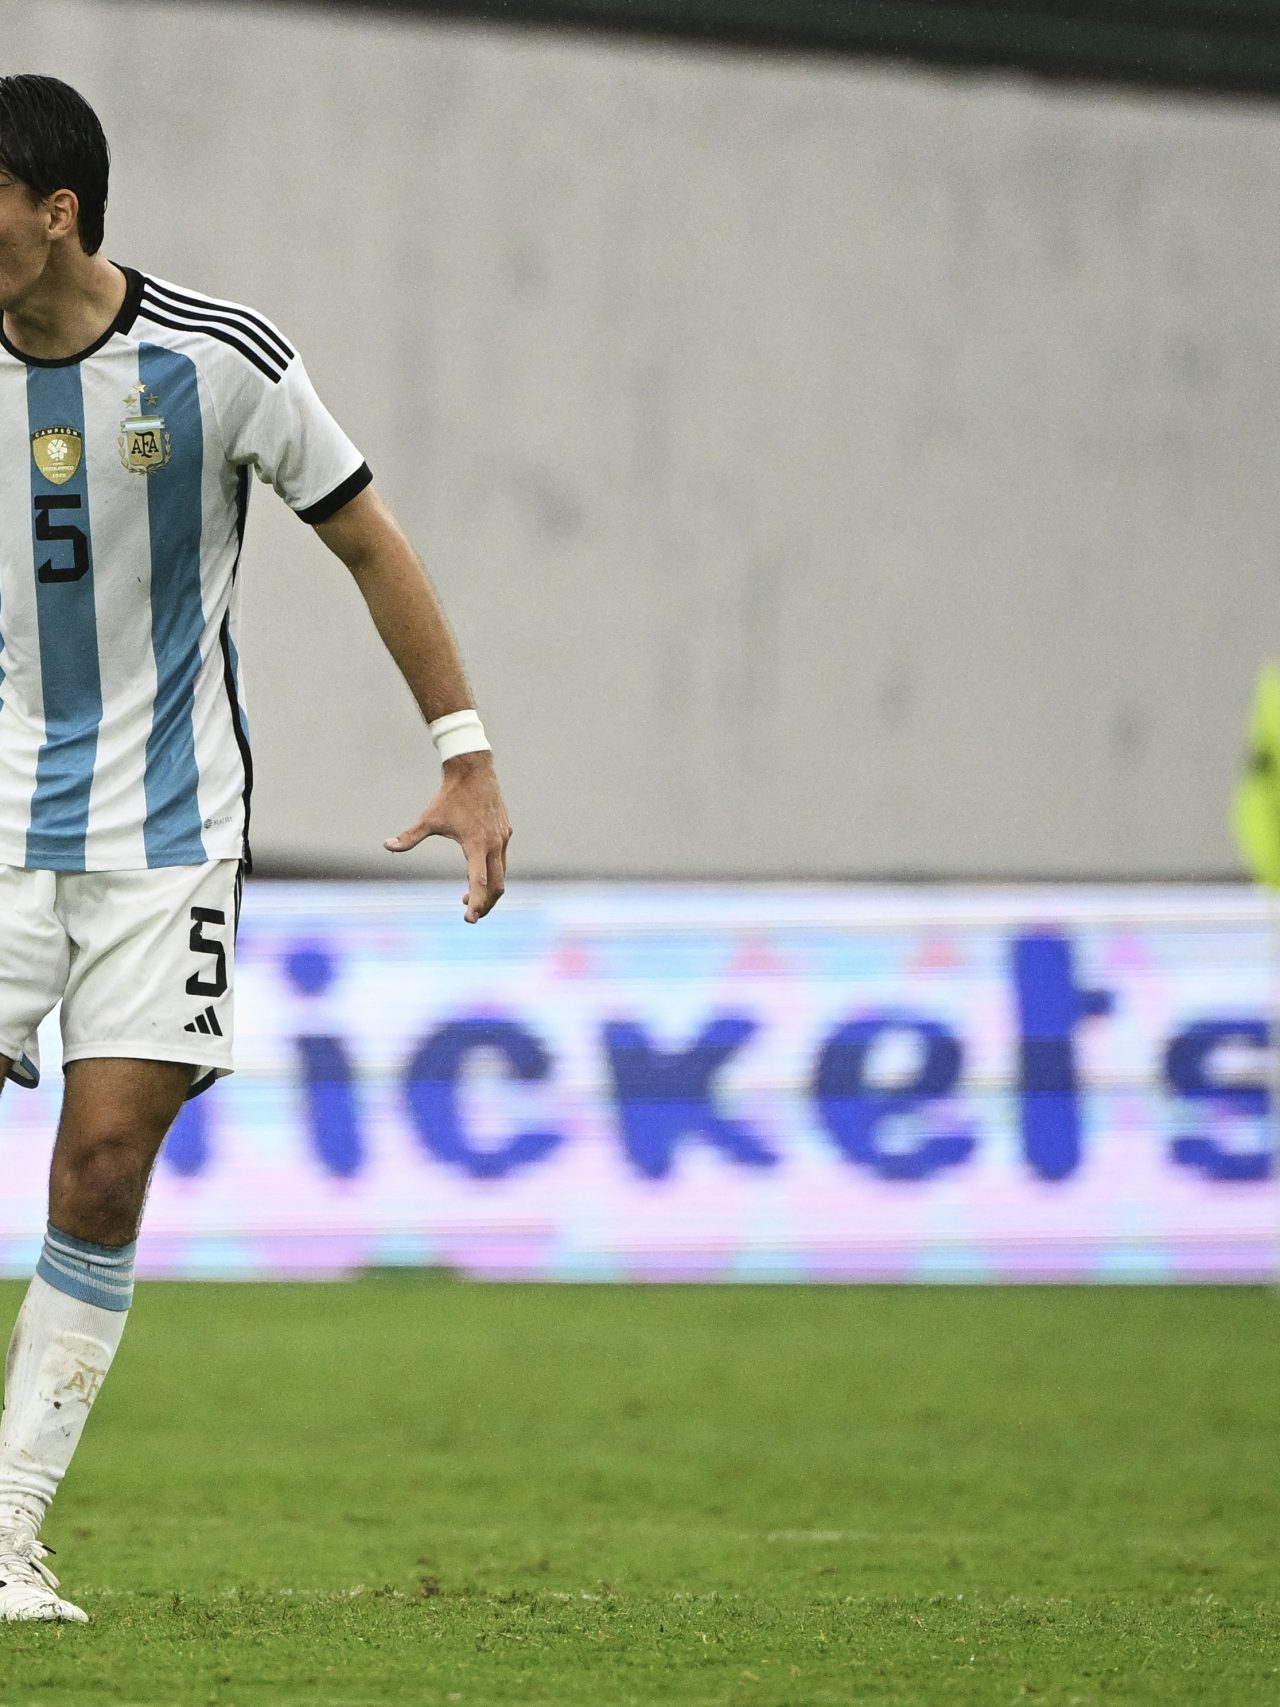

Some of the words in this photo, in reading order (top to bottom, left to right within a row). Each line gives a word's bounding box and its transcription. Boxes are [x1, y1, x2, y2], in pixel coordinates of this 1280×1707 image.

[131, 431, 160, 458] AFA
[34, 494, 89, 584] 5
[185, 906, 228, 997] 5
[162, 922, 1278, 1182] ickets
